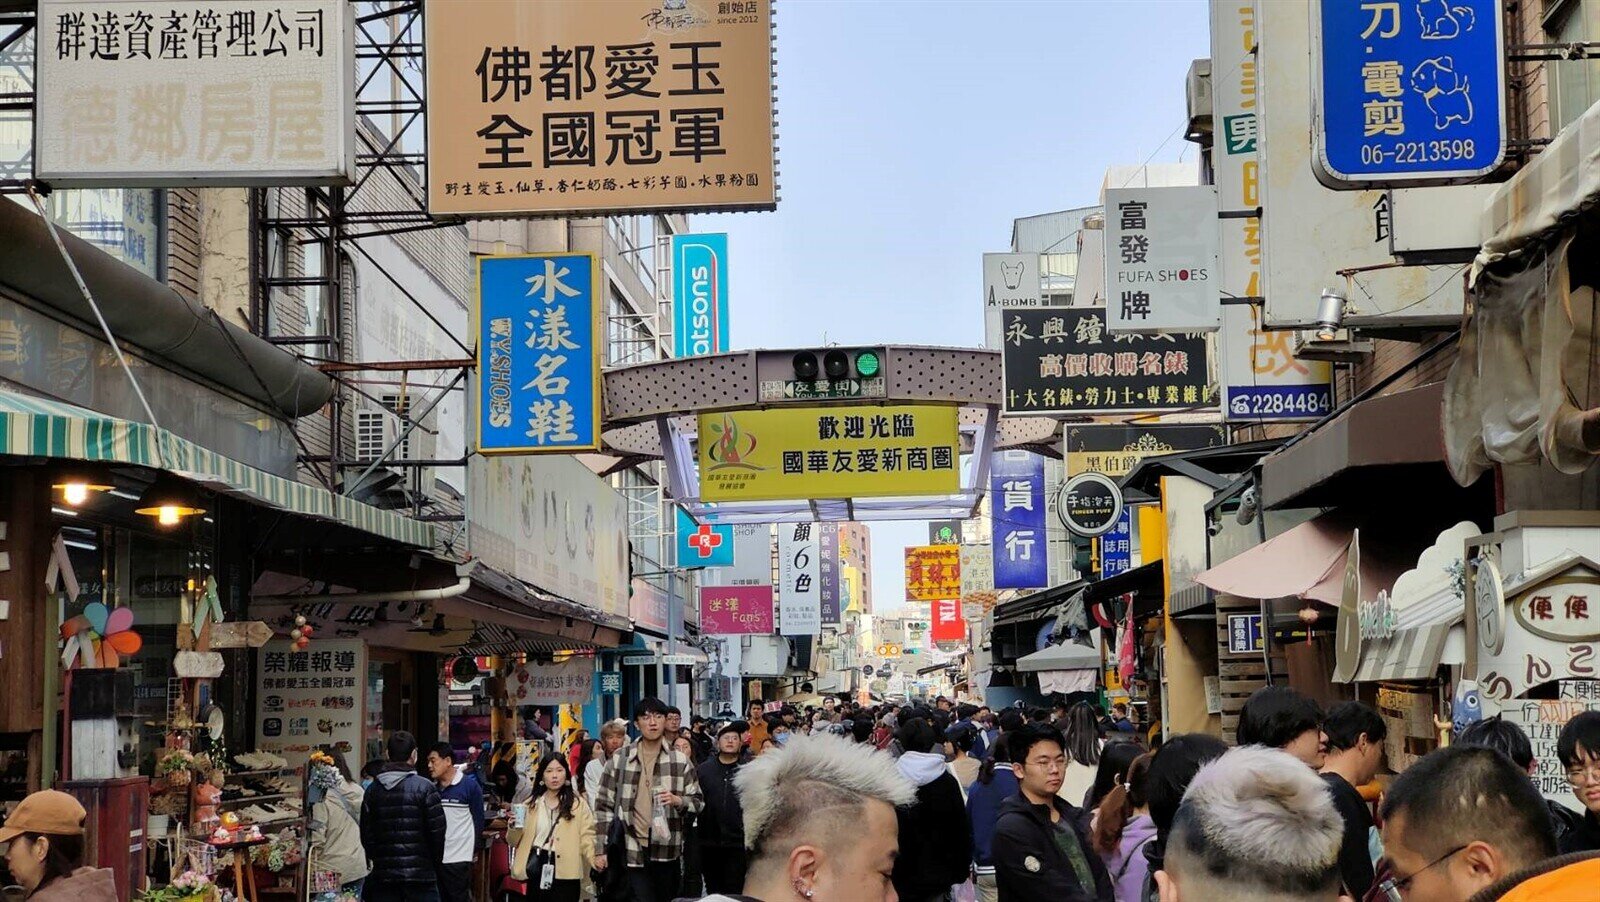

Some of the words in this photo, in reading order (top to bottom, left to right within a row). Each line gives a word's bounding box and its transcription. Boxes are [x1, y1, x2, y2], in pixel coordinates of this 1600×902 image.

[717, 1, 758, 14] 創始店
[717, 16, 737, 24] since
[738, 15, 758, 24] 2012
[55, 9, 323, 61] 群達資產管理公司
[475, 41, 725, 103] 佛都愛玉
[476, 107, 727, 169] 全國冠軍
[1361, 138, 1475, 166] 06-2213598
[1118, 271, 1154, 283] FUFA
[1158, 268, 1208, 281] SHOES
[521, 259, 582, 445] 水漾名鞋
[1039, 351, 1189, 378] 高價收購名錶
[795, 379, 850, 392] 友愛街
[1252, 392, 1330, 414] 2284484
[818, 413, 915, 440] 歡迎光臨
[782, 445, 953, 474] 國華友愛新商圈
[732, 612, 760, 623] Fans
[1528, 595, 1589, 620] 便便
[264, 650, 356, 673] 榮耀報導
[263, 676, 356, 689] 佛都愛玉全國冠軍
[602, 674, 620, 692] 藥
